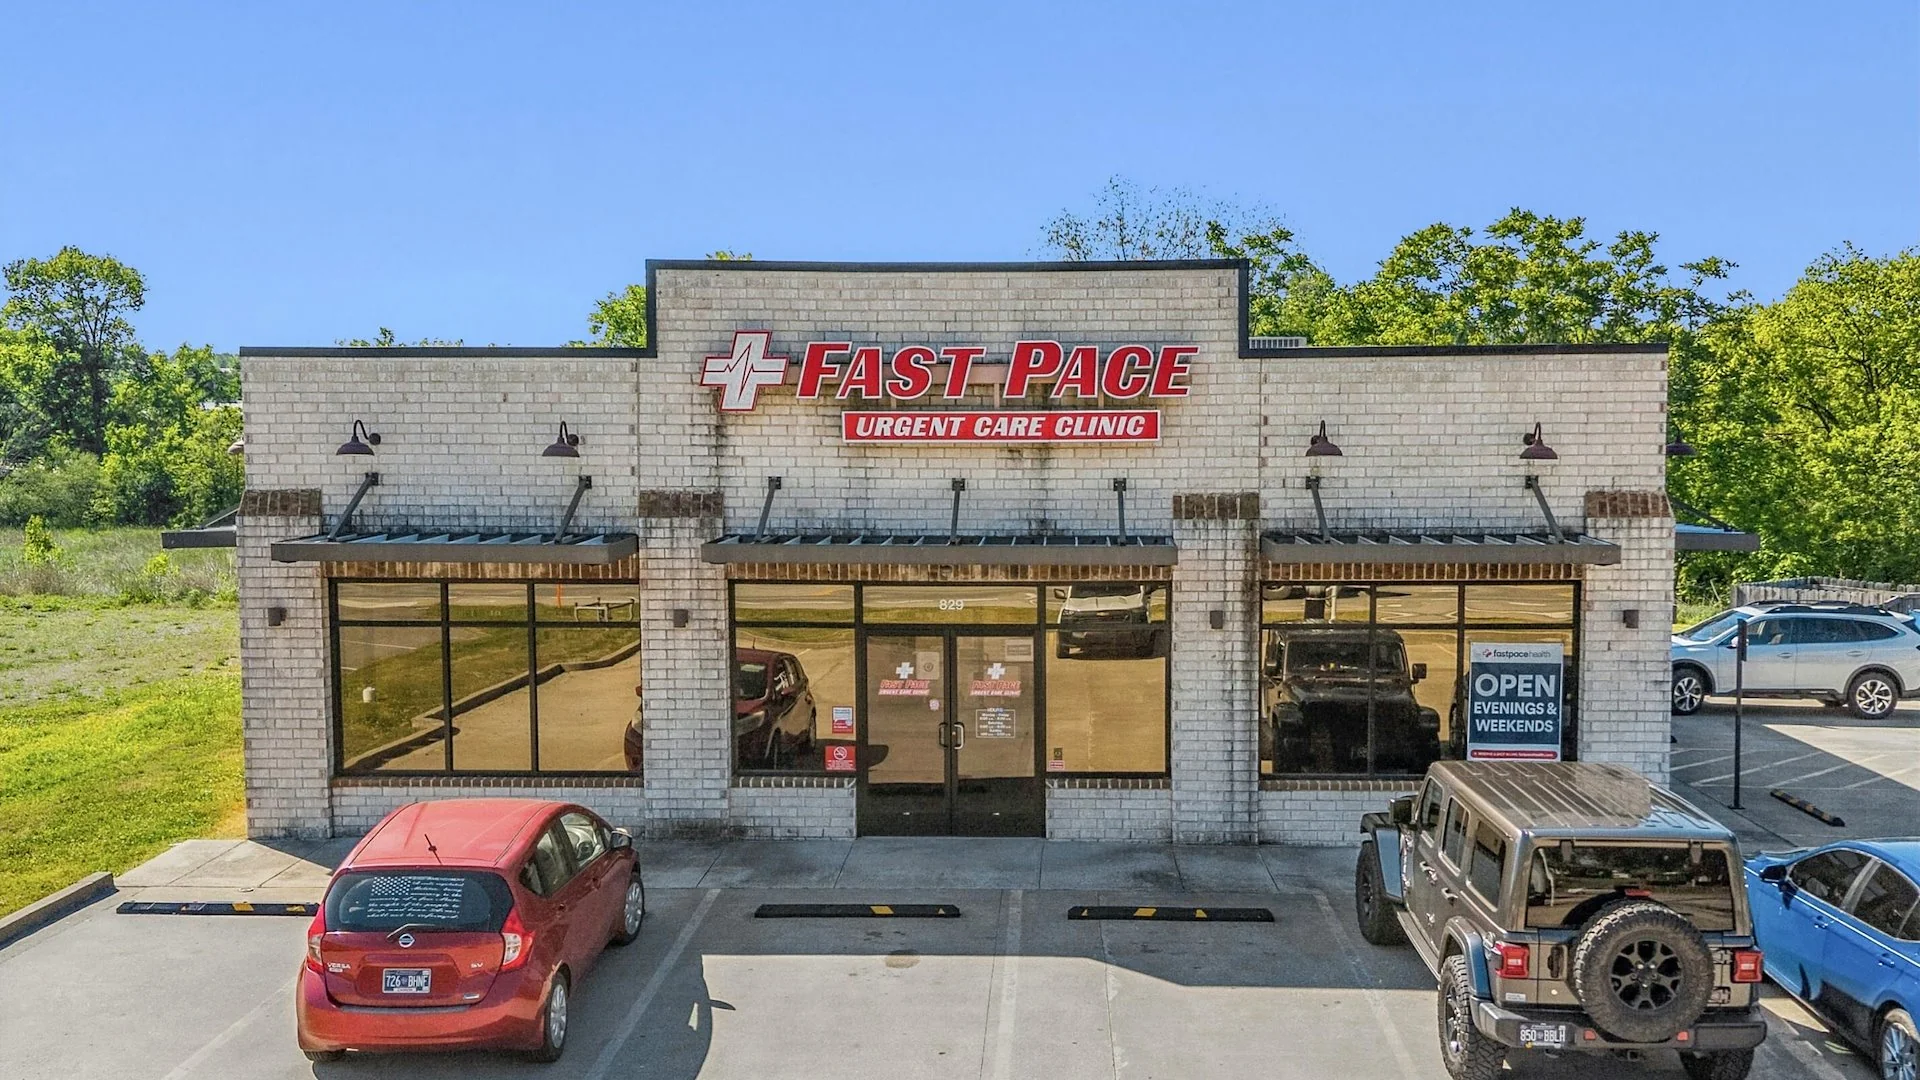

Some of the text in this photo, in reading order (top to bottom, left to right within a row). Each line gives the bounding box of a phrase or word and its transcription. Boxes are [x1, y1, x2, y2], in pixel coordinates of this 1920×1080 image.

[796, 340, 1200, 400] FAST PACE
[855, 415, 1146, 437] URGENT CARE CLINIC
[939, 599, 964, 611] 829
[1475, 673, 1556, 697] OPEN
[1473, 702, 1558, 715] EVENINGS &
[1475, 719, 1554, 733] WEEKENDS
[386, 975, 401, 987] 726
[1520, 1029, 1537, 1041] 850
